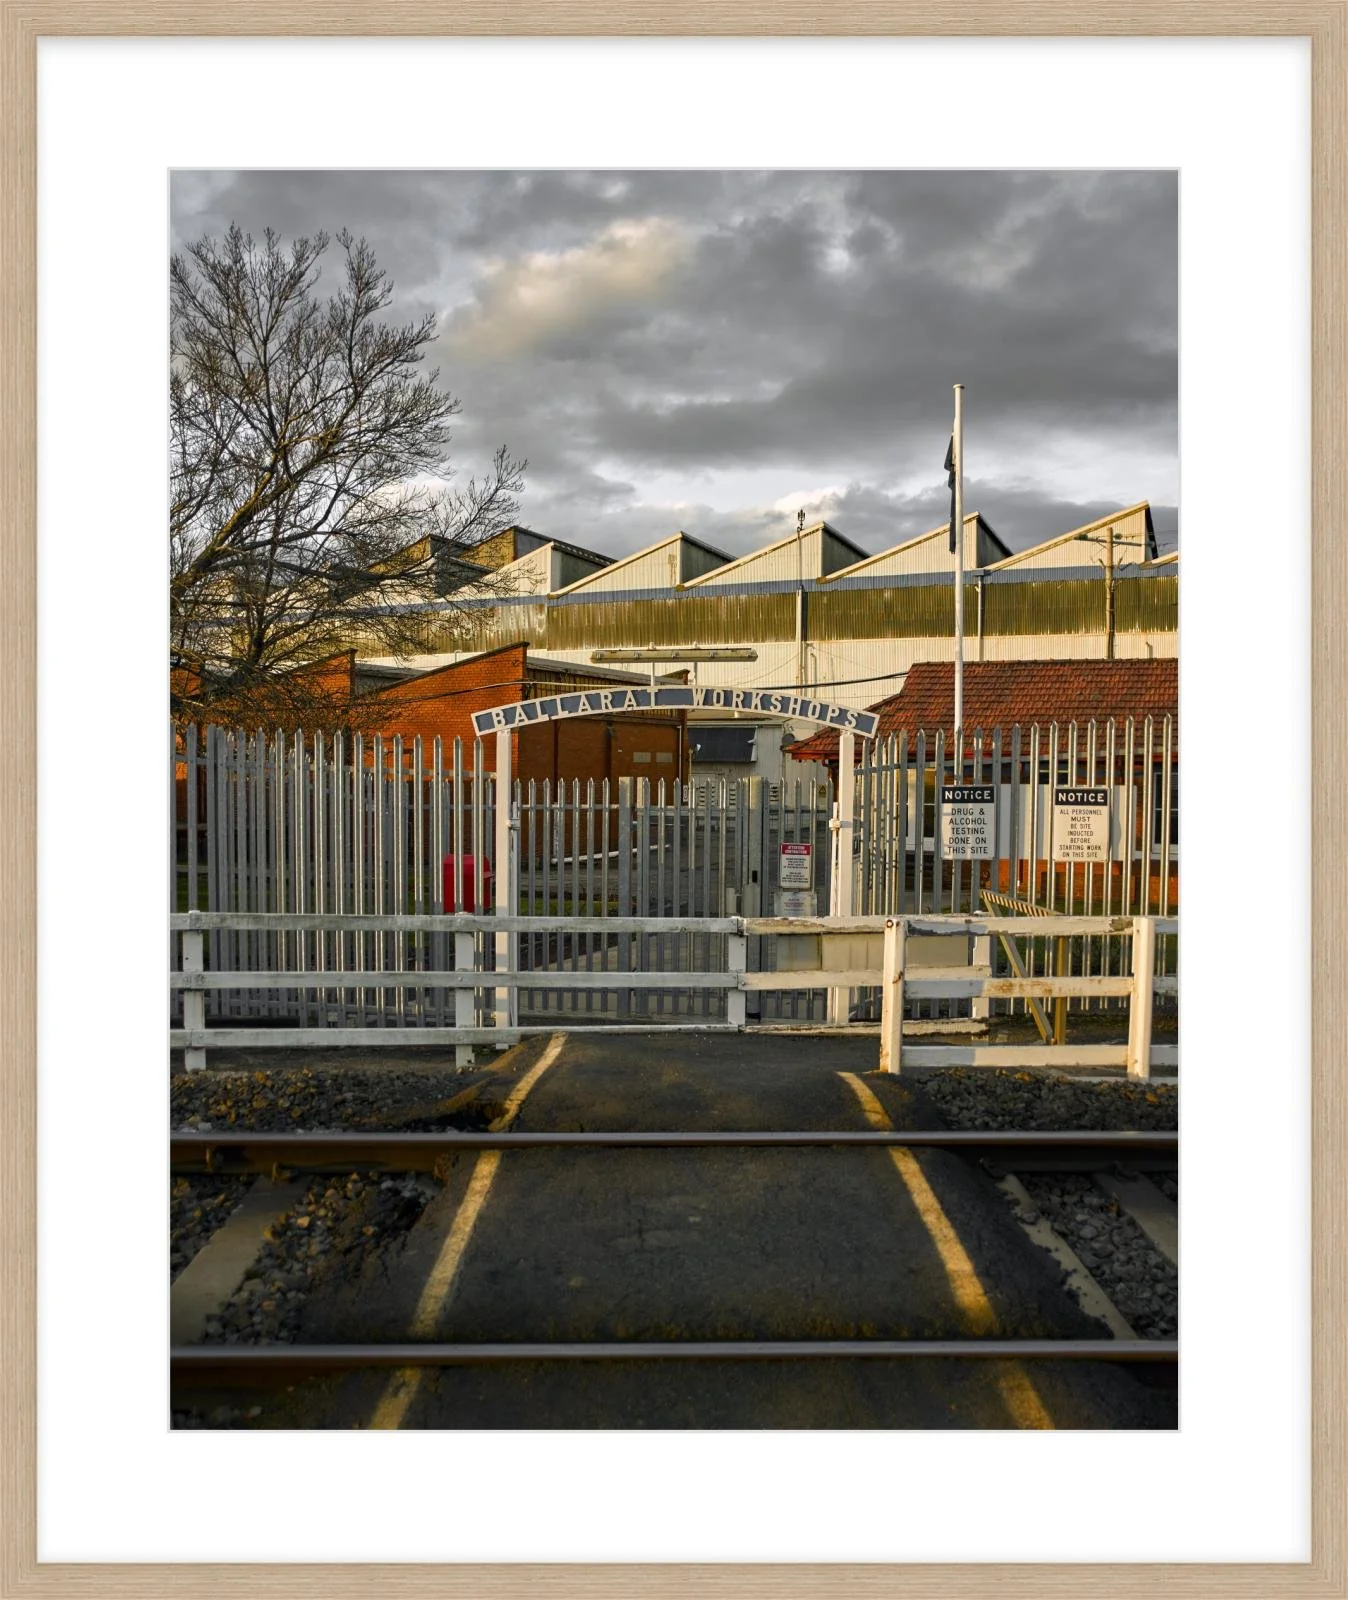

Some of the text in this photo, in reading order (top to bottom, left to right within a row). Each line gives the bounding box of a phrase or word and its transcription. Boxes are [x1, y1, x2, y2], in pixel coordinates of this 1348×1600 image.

[492, 688, 859, 728] BALLARAT WORKSHOPS
[944, 790, 991, 800] NOTICE
[1058, 792, 1105, 802] NOTICE
[951, 808, 985, 816] DRUG &
[951, 827, 985, 835] TESTING
[948, 837, 987, 845] DONE ON
